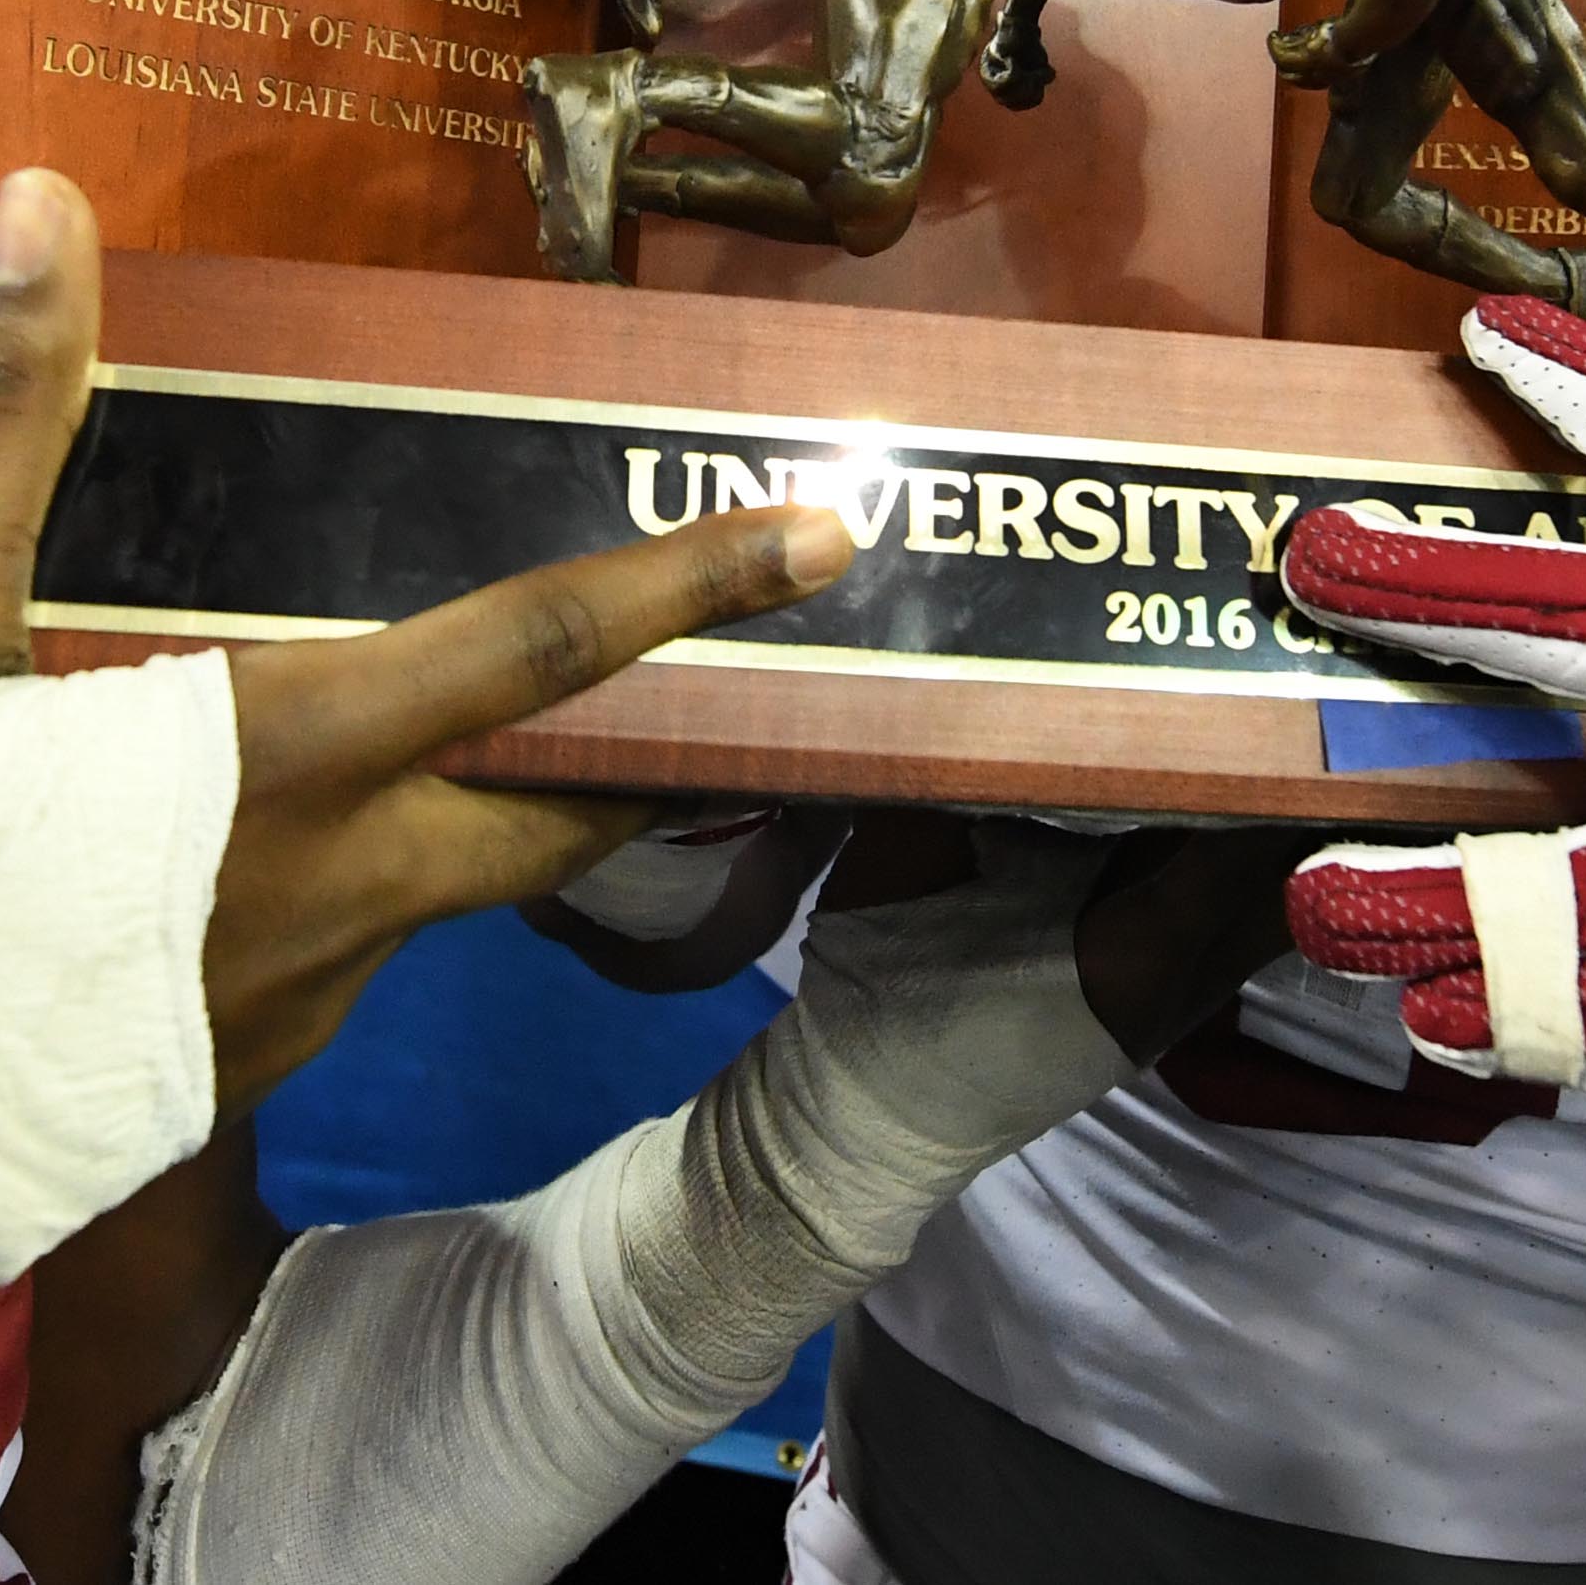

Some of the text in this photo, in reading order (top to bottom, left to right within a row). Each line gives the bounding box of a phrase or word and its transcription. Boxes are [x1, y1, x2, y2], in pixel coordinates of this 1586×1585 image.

[309, 14, 355, 51] OF
[365, 22, 531, 85] KENTUCKY
[43, 36, 536, 150] LOUISIANA STATE UNIVERSIT
[1415, 141, 1531, 172] TEXAS
[625, 446, 1300, 574] UNIVERSITY
[1104, 590, 1256, 651] 2016
